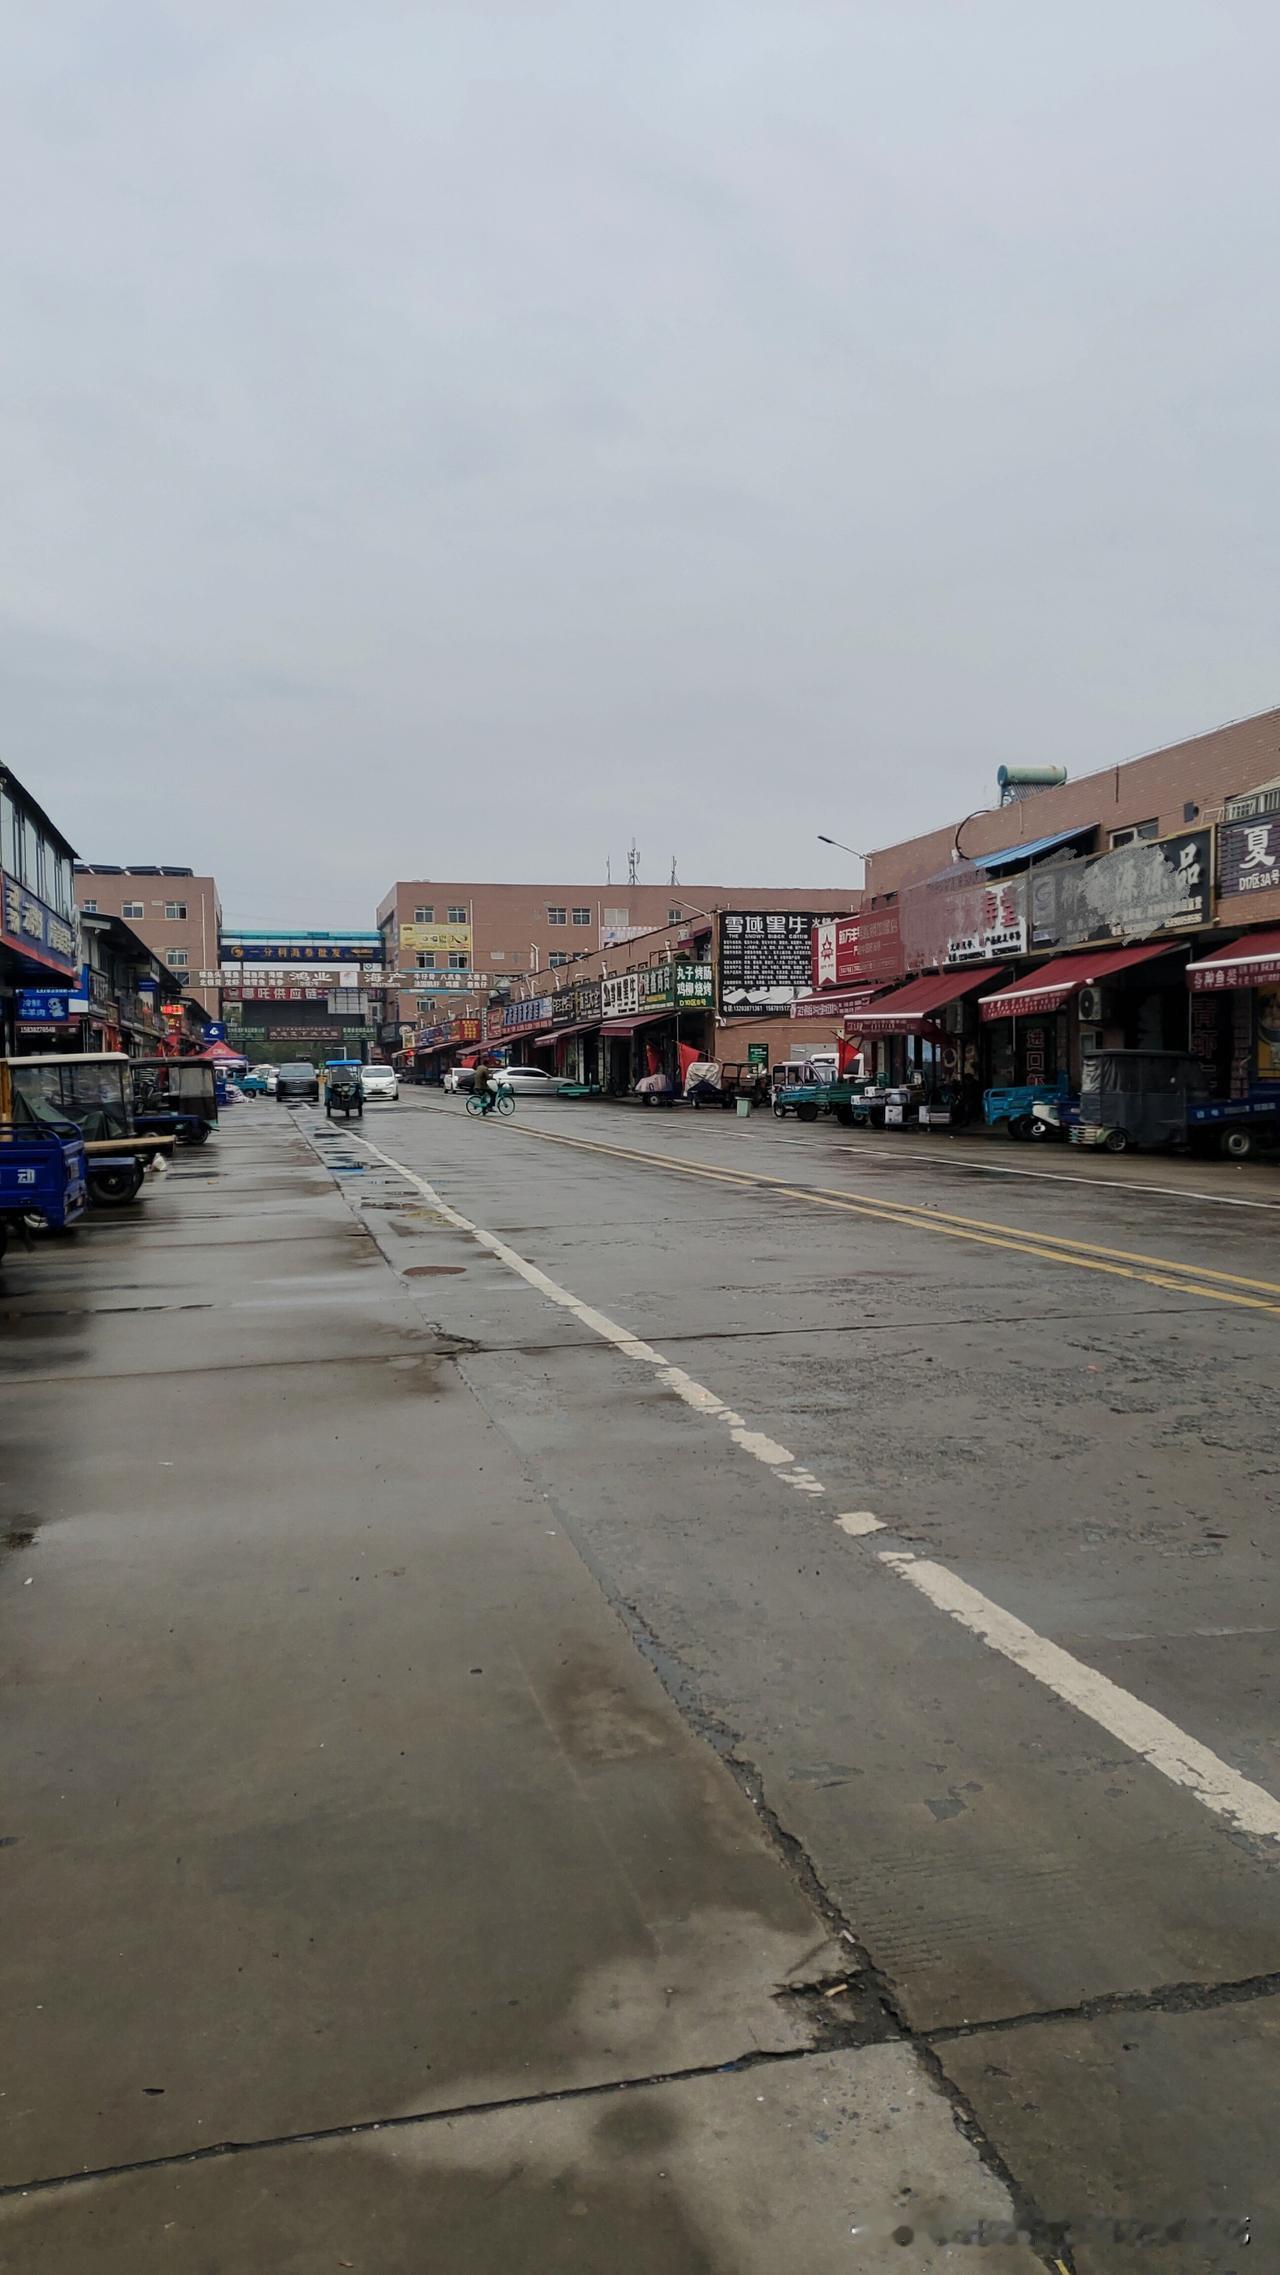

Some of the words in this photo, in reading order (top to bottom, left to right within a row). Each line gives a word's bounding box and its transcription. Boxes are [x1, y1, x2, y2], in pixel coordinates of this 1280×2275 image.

[1239, 825, 1276, 869] 夏
[725, 916, 808, 934] 雪域黑牛
[289, 971, 333, 981] 鸿业
[364, 972, 407, 982] 海产
[676, 965, 712, 980] 丸子烤肠
[676, 981, 712, 997] 鸡柳烧烤
[17, 1168, 35, 1184] 动
